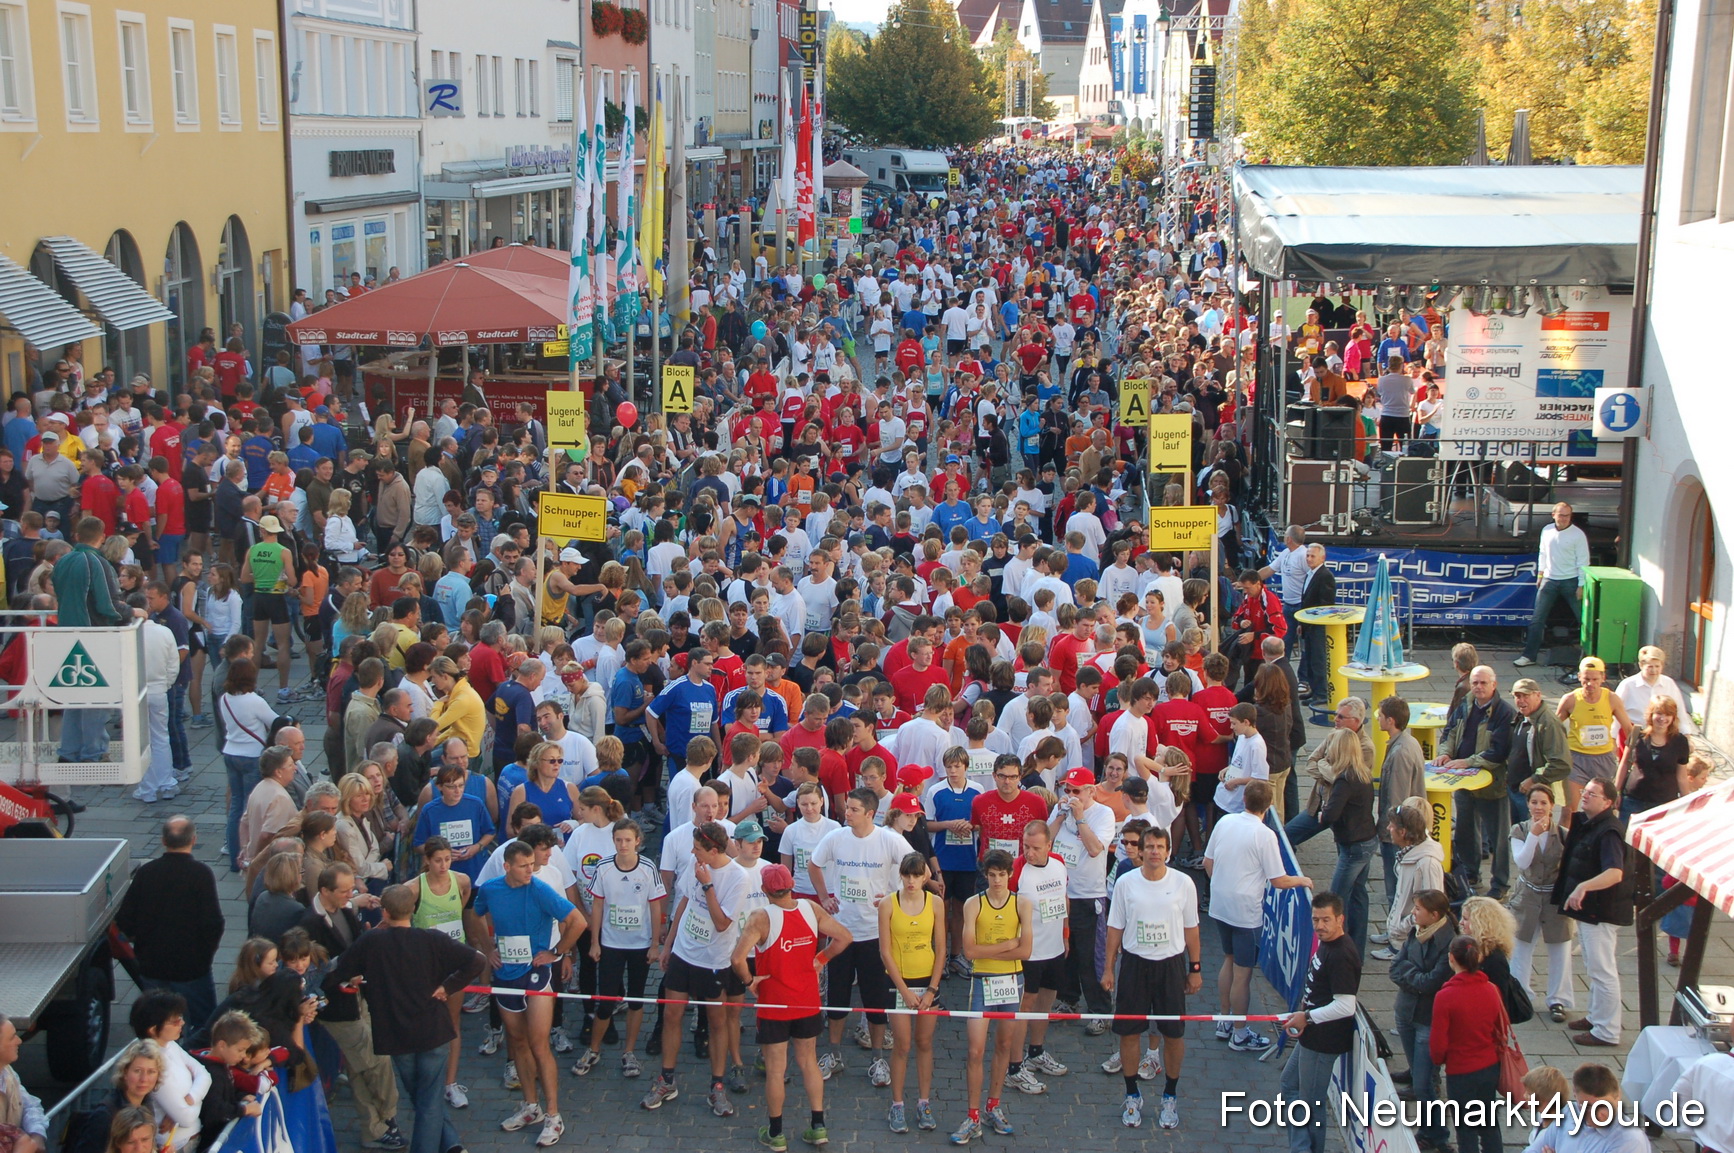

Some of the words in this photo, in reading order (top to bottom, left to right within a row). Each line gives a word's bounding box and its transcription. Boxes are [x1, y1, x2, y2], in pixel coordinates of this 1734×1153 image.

[1113, 173, 1119, 182] B
[336, 332, 378, 340] Stadtcafé
[477, 330, 519, 339] Stadtcafé
[666, 368, 690, 377] Block
[1123, 381, 1148, 390] Block
[669, 380, 687, 403] A
[1126, 393, 1145, 416] A
[549, 407, 584, 419] Jugend-
[558, 418, 575, 427] lauf
[1152, 430, 1190, 442] Jugend-
[1452, 428, 1564, 437] AKTIENGESELLSCHAFT
[1163, 441, 1180, 450] lauf
[544, 505, 602, 519] Schnupper-
[563, 519, 582, 528] lauf
[1154, 519, 1212, 530] Schnupper-
[1173, 531, 1192, 540] lauf
[1377, 558, 1537, 580] THUNDER
[690, 701, 713, 710] HUBER
[975, 762, 993, 770] 5119
[450, 831, 470, 840] 5089
[1036, 880, 1062, 893] ERDINGER
[583, 891, 593, 899] 50
[847, 888, 867, 898] 5088
[1048, 903, 1065, 914] 5188
[618, 916, 639, 925] 5129
[690, 923, 710, 938] 5085
[1146, 932, 1167, 941] 5131
[780, 937, 793, 953] LG
[507, 948, 529, 957] 5165
[993, 987, 1016, 997] 5080
